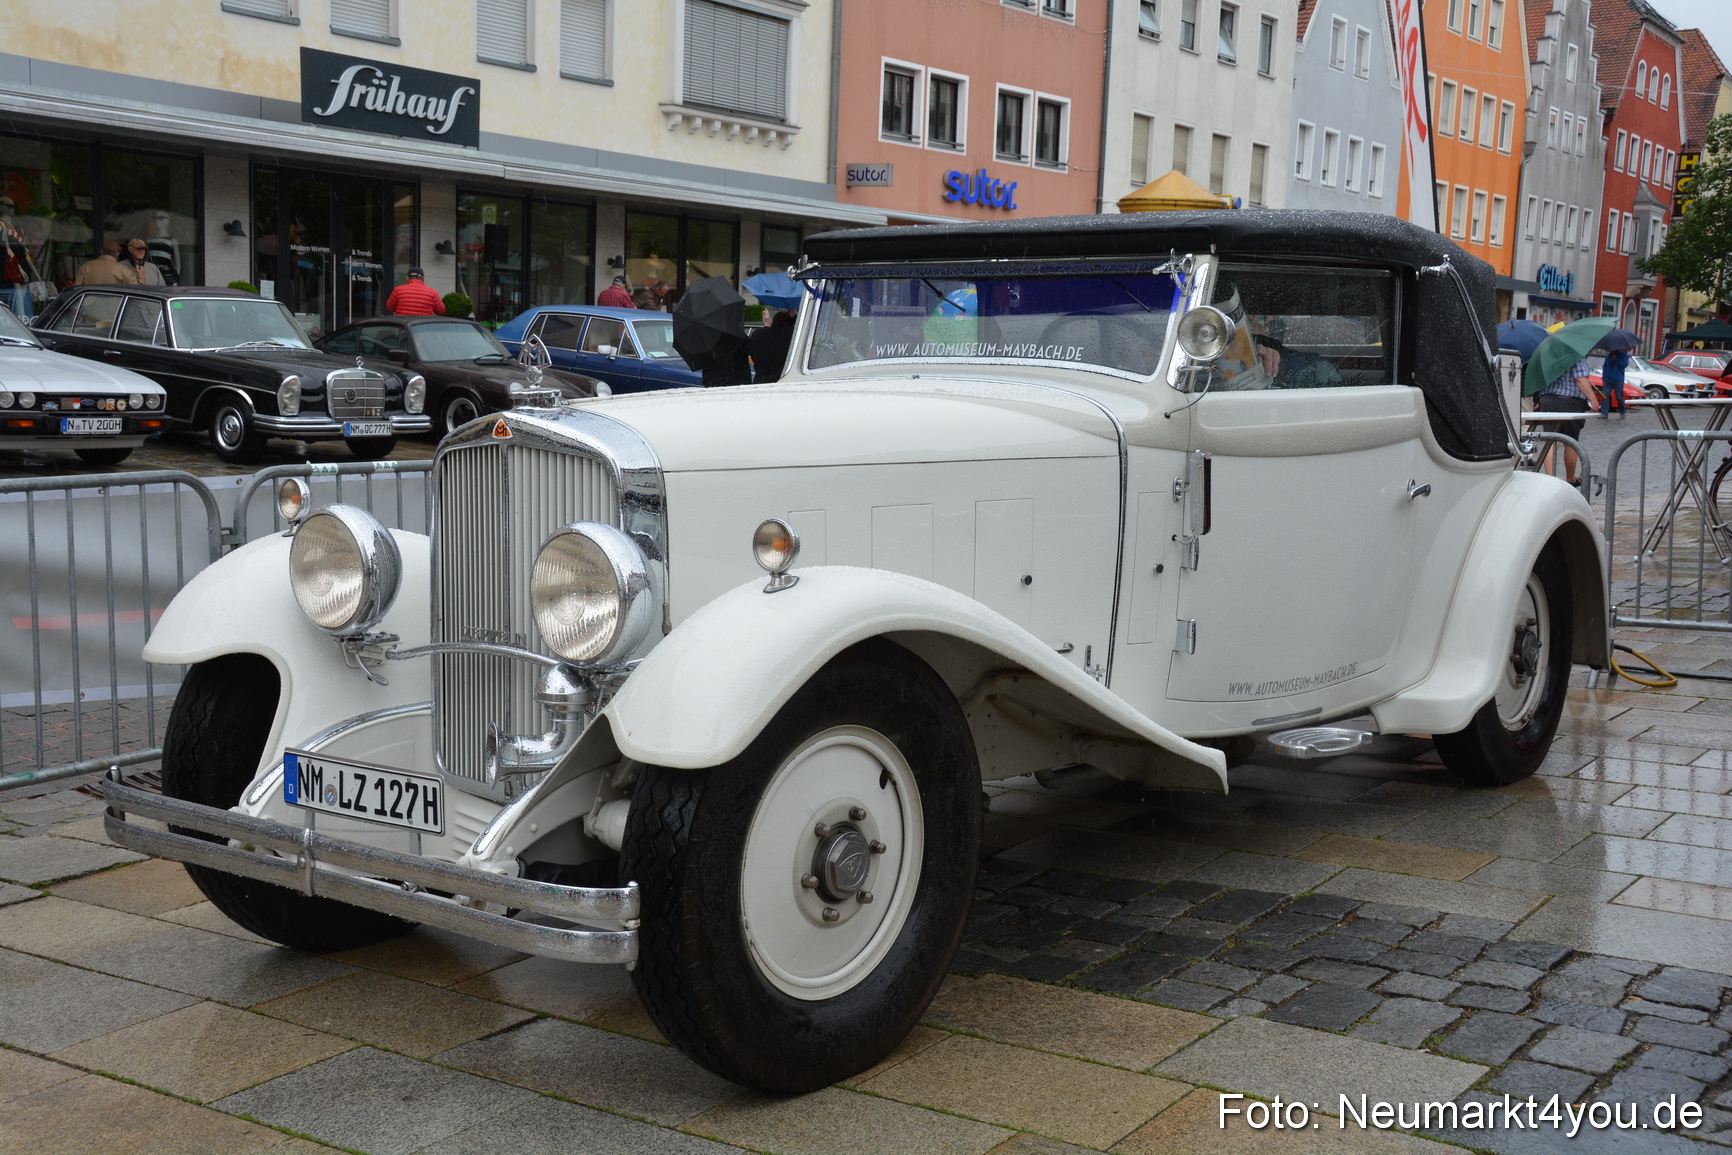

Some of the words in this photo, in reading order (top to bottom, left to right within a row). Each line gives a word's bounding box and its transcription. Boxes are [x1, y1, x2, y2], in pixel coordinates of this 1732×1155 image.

[313, 64, 476, 135] frühauf
[1676, 154, 1700, 225] HOT
[290, 244, 310, 252] Modern
[310, 245, 330, 253] Women
[357, 249, 372, 257] Trends
[364, 261, 383, 269] Women
[1539, 264, 1568, 293] Eilles
[876, 343, 909, 357] WWW.
[912, 342, 1084, 361] AUTOMUSEUM-MAYBACH.DE
[67, 419, 75, 430] N
[81, 419, 95, 430] TV
[96, 419, 121, 430] 200H
[350, 424, 360, 434] NM
[462, 626, 527, 647] ZEPPELN
[1228, 682, 1253, 696] WWW.
[1254, 661, 1358, 696] AUTOMUSEUM-MAYBACH.DE
[297, 761, 323, 803] NM
[338, 770, 367, 813] LZ
[374, 777, 439, 826] 127H
